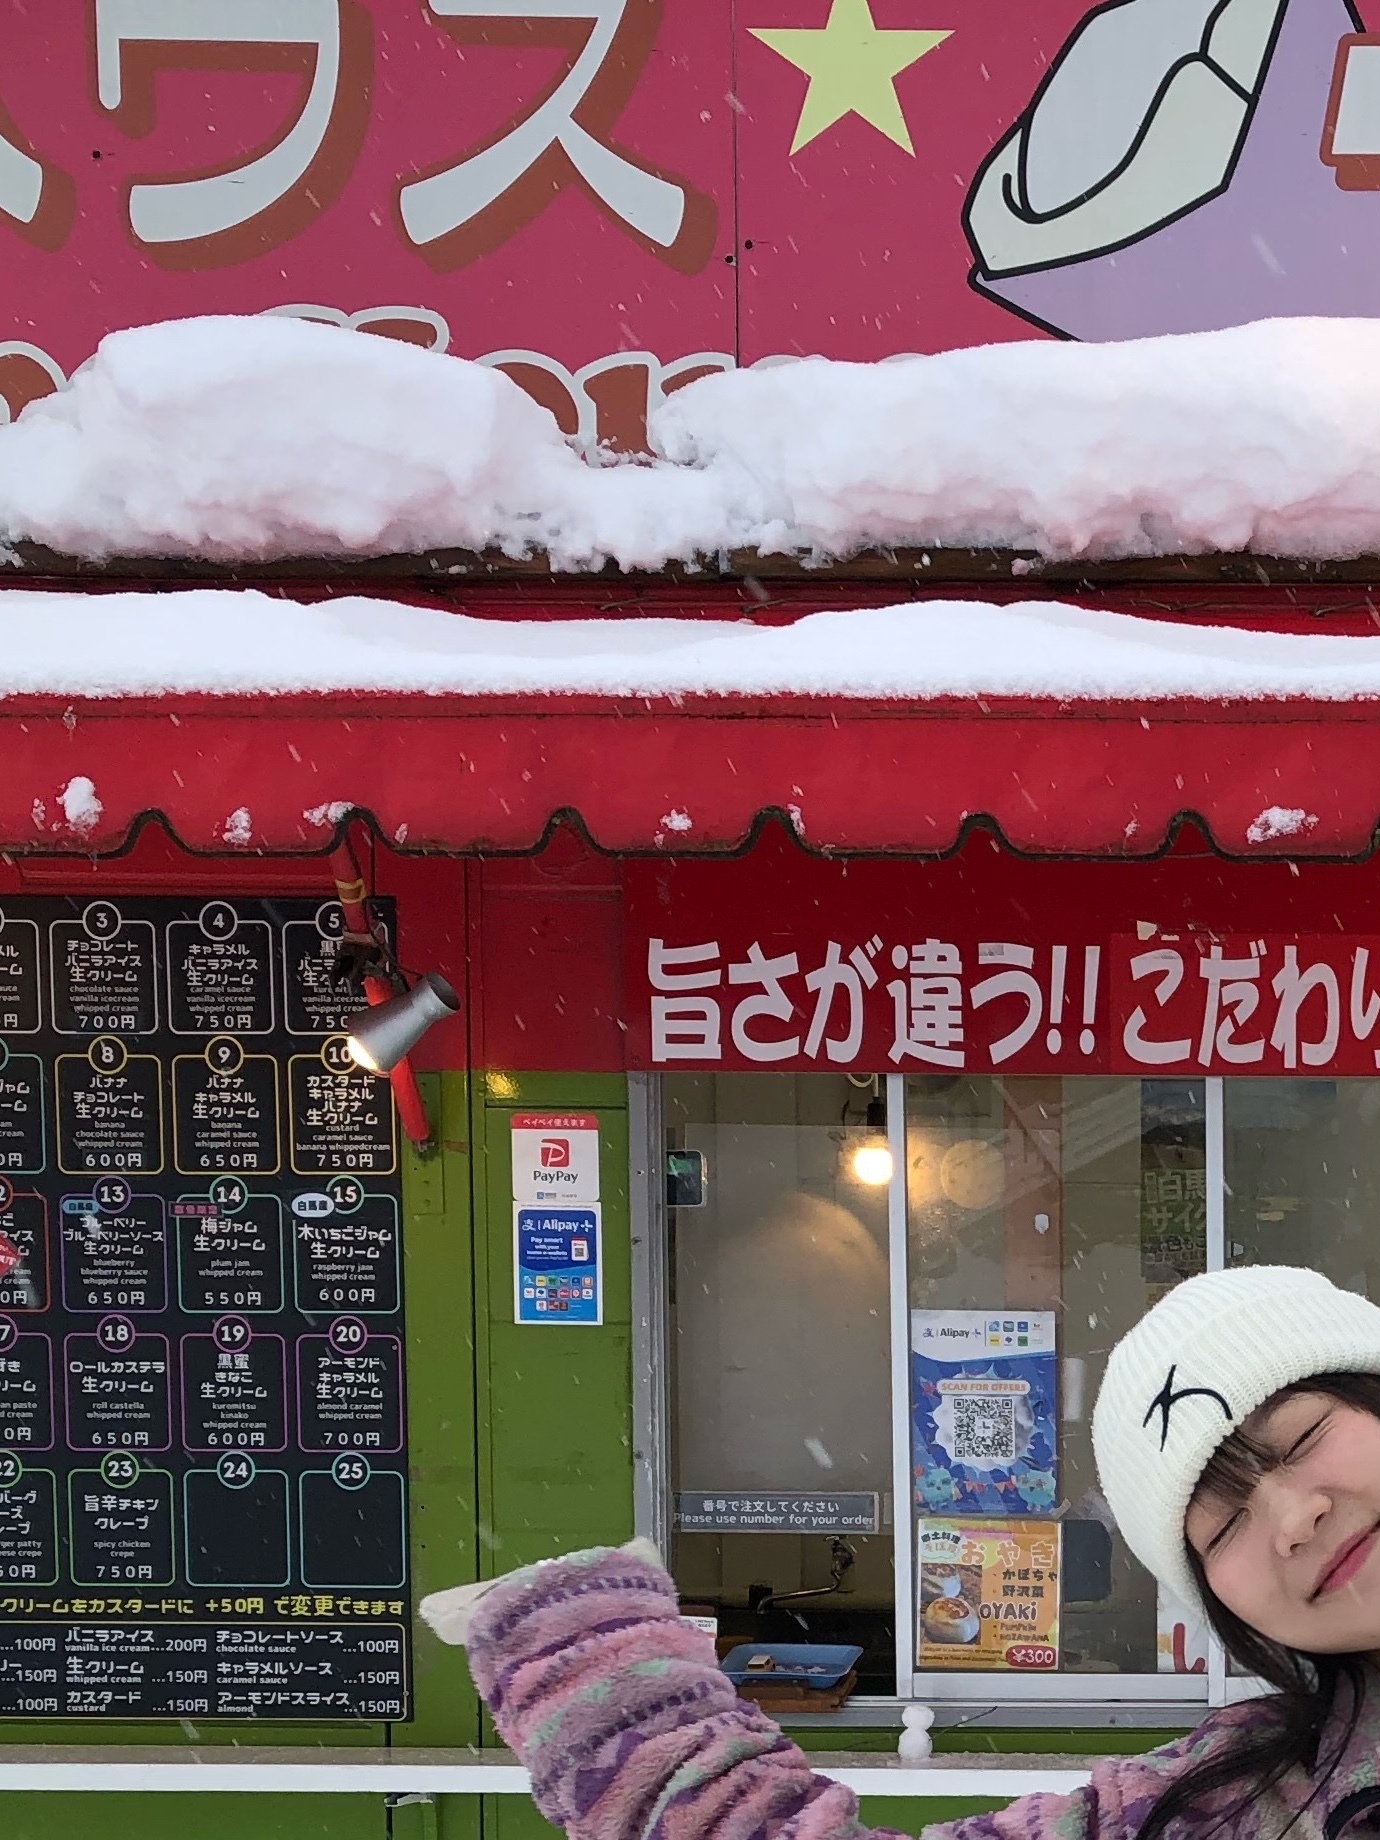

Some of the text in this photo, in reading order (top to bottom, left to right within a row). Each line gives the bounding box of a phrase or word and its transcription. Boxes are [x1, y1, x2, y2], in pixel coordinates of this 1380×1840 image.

[96, 912, 108, 928] 3
[213, 913, 224, 928] 4
[328, 913, 340, 928] 5
[67, 940, 138, 951] チョコレート
[189, 944, 250, 955] キャラメル
[65, 953, 142, 966] バニラアイス
[181, 956, 258, 970] バニラアイス
[70, 966, 138, 981] 生クリーム
[187, 970, 253, 986] 生クリーム
[70, 985, 111, 993] chocolate
[101, 1046, 114, 1063] 8
[218, 1046, 231, 1064] 9
[89, 1074, 128, 1088] バナナ
[206, 1075, 244, 1088] バナナ
[306, 1076, 376, 1088] カスタード
[73, 1091, 145, 1103] チョコレート
[195, 1092, 257, 1103] キャラメル
[309, 1088, 375, 1100] キャラメル
[75, 1103, 144, 1118] 生クリーム
[192, 1103, 260, 1119] 生クリーム
[322, 1098, 362, 1112] バナナ
[306, 1109, 378, 1126] 生クリーム
[75, 1130, 118, 1138] chocolate
[326, 1124, 360, 1132] custard
[533, 1170, 578, 1184] PayPay
[100, 1185, 125, 1203] 13
[217, 1186, 241, 1203] 14
[333, 1186, 357, 1203] 15
[201, 1218, 258, 1234] 梅ジャム
[298, 1224, 392, 1241] 木いちごジャム
[63, 1228, 164, 1242] ブルーベリーソース
[83, 1241, 144, 1255] 生クリーム
[193, 1235, 266, 1252] 生クリーム
[311, 1242, 379, 1259] 生クリーム
[313, 1263, 355, 1272] raspberry
[104, 1325, 129, 1342] 18
[220, 1325, 245, 1342] 19
[336, 1325, 361, 1343] 20
[940, 1328, 970, 1339] Alipay
[70, 1361, 165, 1373] ロールカステラ
[317, 1357, 380, 1369] アーモンド
[214, 1371, 253, 1383] きなこ
[318, 1372, 380, 1384] キャラメル
[81, 1376, 154, 1393] 生クリーム
[200, 1382, 268, 1399] 生クリーム
[316, 1383, 383, 1399] 生クリーム
[941, 1382, 1027, 1391] SCAN FOR OFFERS
[212, 1402, 257, 1411] kuromitsu
[317, 1402, 383, 1410] almond caramel
[108, 1460, 133, 1477] 23
[223, 1462, 249, 1478] 24
[338, 1462, 363, 1479] 25
[84, 1494, 159, 1511] 旨辛チキン
[702, 1500, 840, 1513] 番号で注文してください
[94, 1515, 149, 1530] クレープ
[674, 1513, 874, 1527] Please use number for your order
[117, 1540, 151, 1548] chicken
[961, 1540, 1055, 1569] おやき
[1003, 1568, 1057, 1581] かぼちゃ
[274, 1595, 404, 1616] で変更できます
[65, 1627, 154, 1642] バニラアイス
[216, 1630, 344, 1644] チョコレートソース
[216, 1645, 265, 1653] chocolate
[66, 1656, 144, 1674] 生クリーム
[216, 1662, 333, 1675] キャラメルソース
[66, 1675, 107, 1685] whipped
[67, 1691, 141, 1704] カスタード
[217, 1692, 350, 1705] アーモンドスライス
[67, 1704, 106, 1712] custard
[217, 1705, 254, 1713] almond
